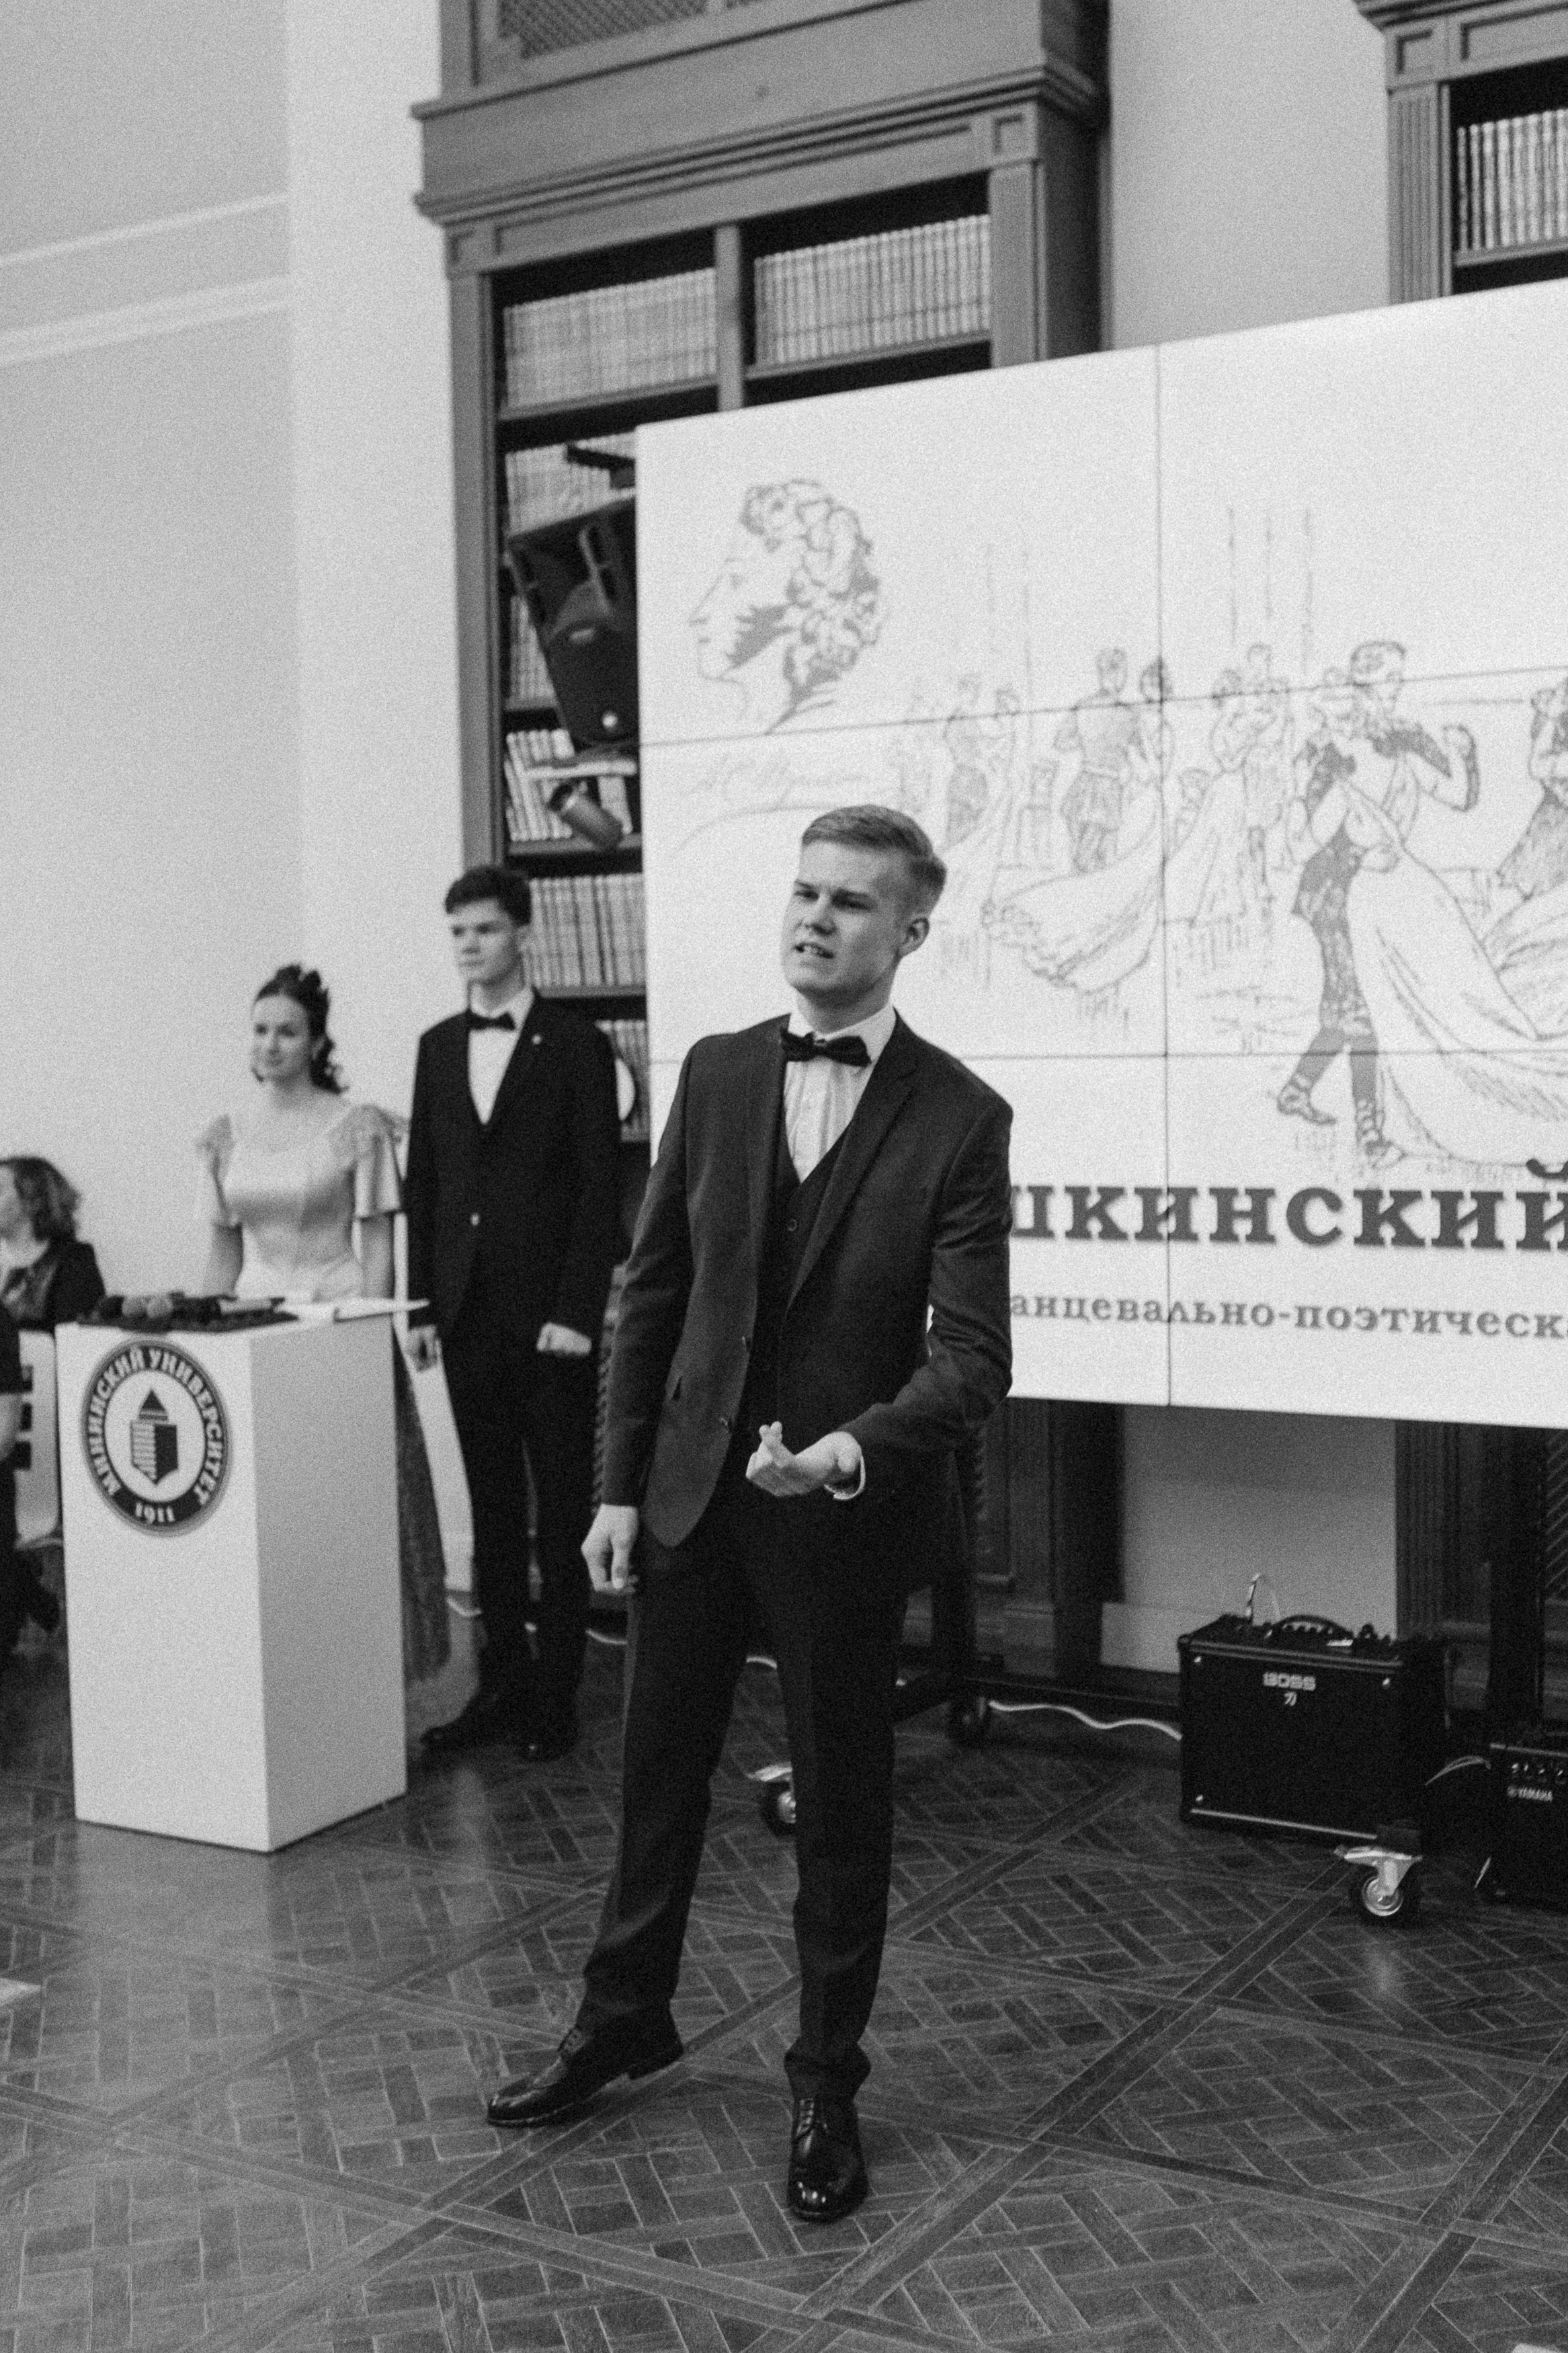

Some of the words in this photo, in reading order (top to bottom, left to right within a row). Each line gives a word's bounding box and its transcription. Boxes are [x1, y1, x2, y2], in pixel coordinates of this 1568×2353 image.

[1011, 1295, 1568, 1339] анцевально-поэтическ
[148, 1347, 223, 1505] УНИВЕРСИТЕТ
[134, 1503, 176, 1525] 1911
[1263, 1671, 1317, 1691] BOSS
[1518, 1787, 1553, 1802] YAMAHA
